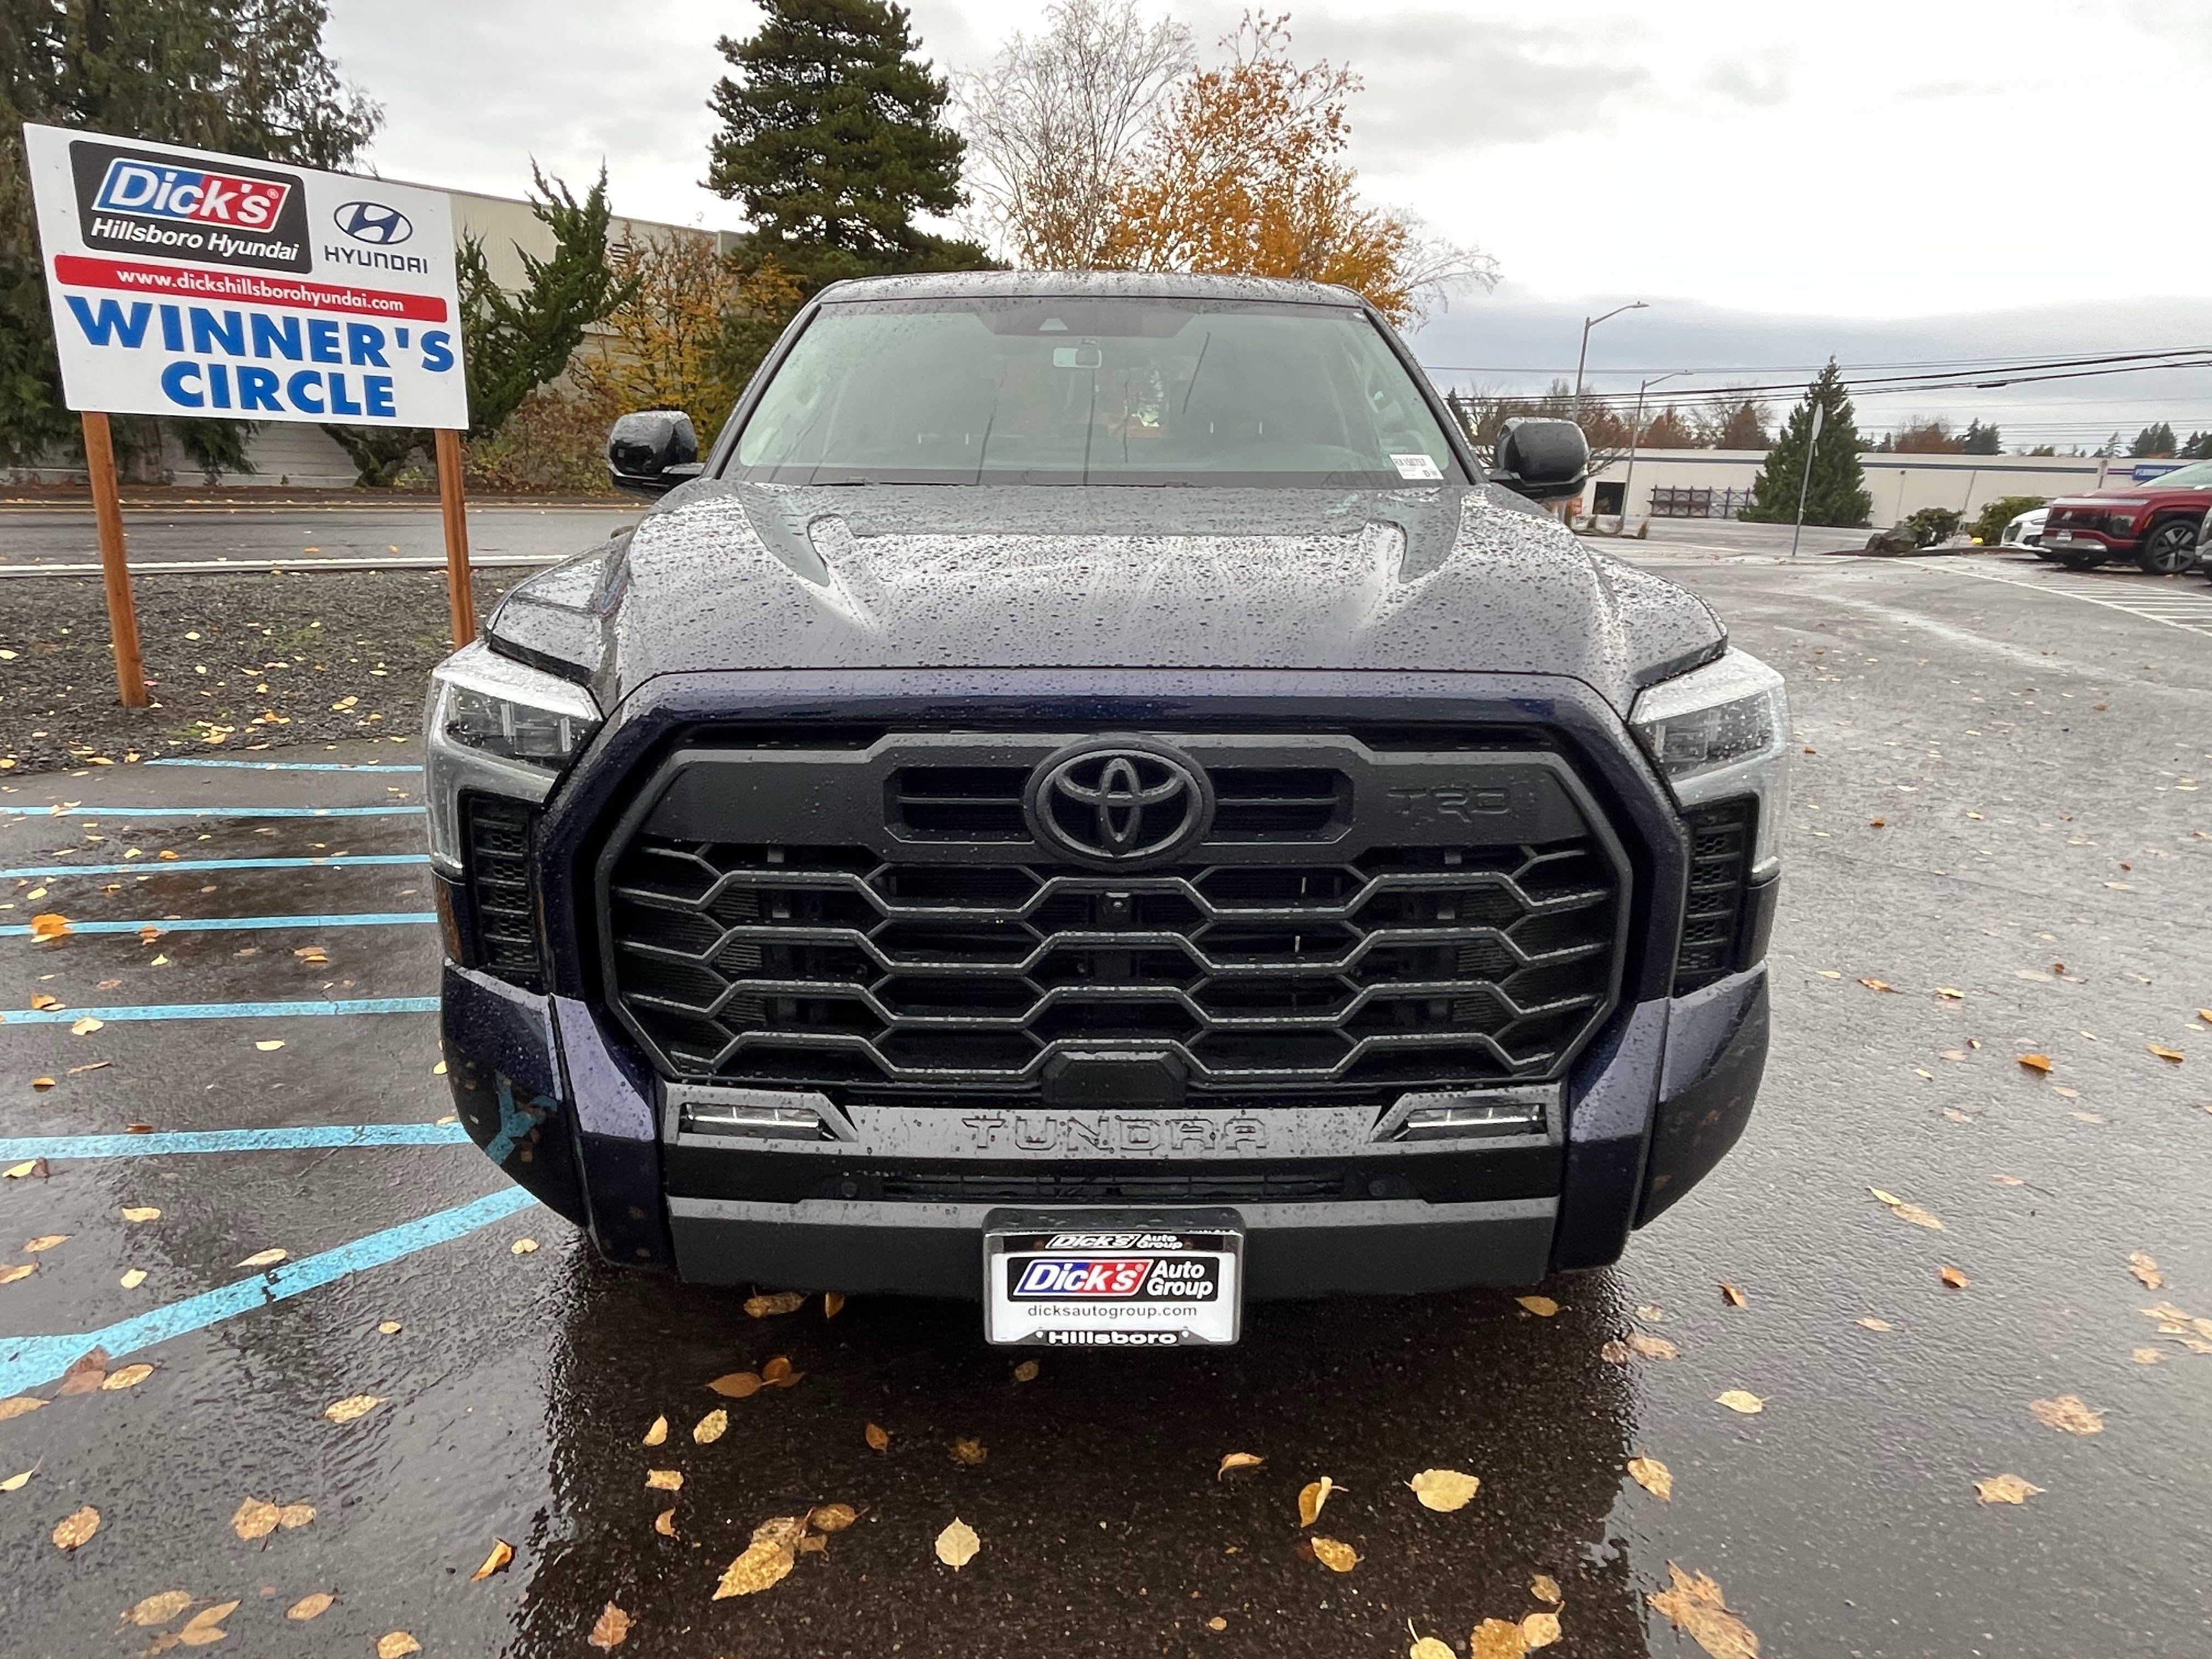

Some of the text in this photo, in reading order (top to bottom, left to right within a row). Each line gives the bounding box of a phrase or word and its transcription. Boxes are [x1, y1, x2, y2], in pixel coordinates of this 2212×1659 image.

[109, 166, 271, 224] Dick's
[91, 217, 300, 262] Hillsboro Hyundai
[324, 245, 428, 274] HYUNDAI
[117, 270, 405, 313] www.dickshillsborohyundai.com
[64, 295, 455, 373] WINNER'S
[160, 360, 397, 417] CIRCLE
[1387, 787, 1510, 823] TRD
[962, 1116, 1267, 1152] TUNDRA
[1137, 1240, 1183, 1250] Group
[1141, 1234, 1177, 1242] Auto
[1023, 1262, 1138, 1291] Dick's
[1152, 1260, 1205, 1279] Auto
[1147, 1278, 1214, 1299] Group
[1028, 1305, 1198, 1319] dicksautogroup.com
[1048, 1331, 1178, 1345] Hillsboro
